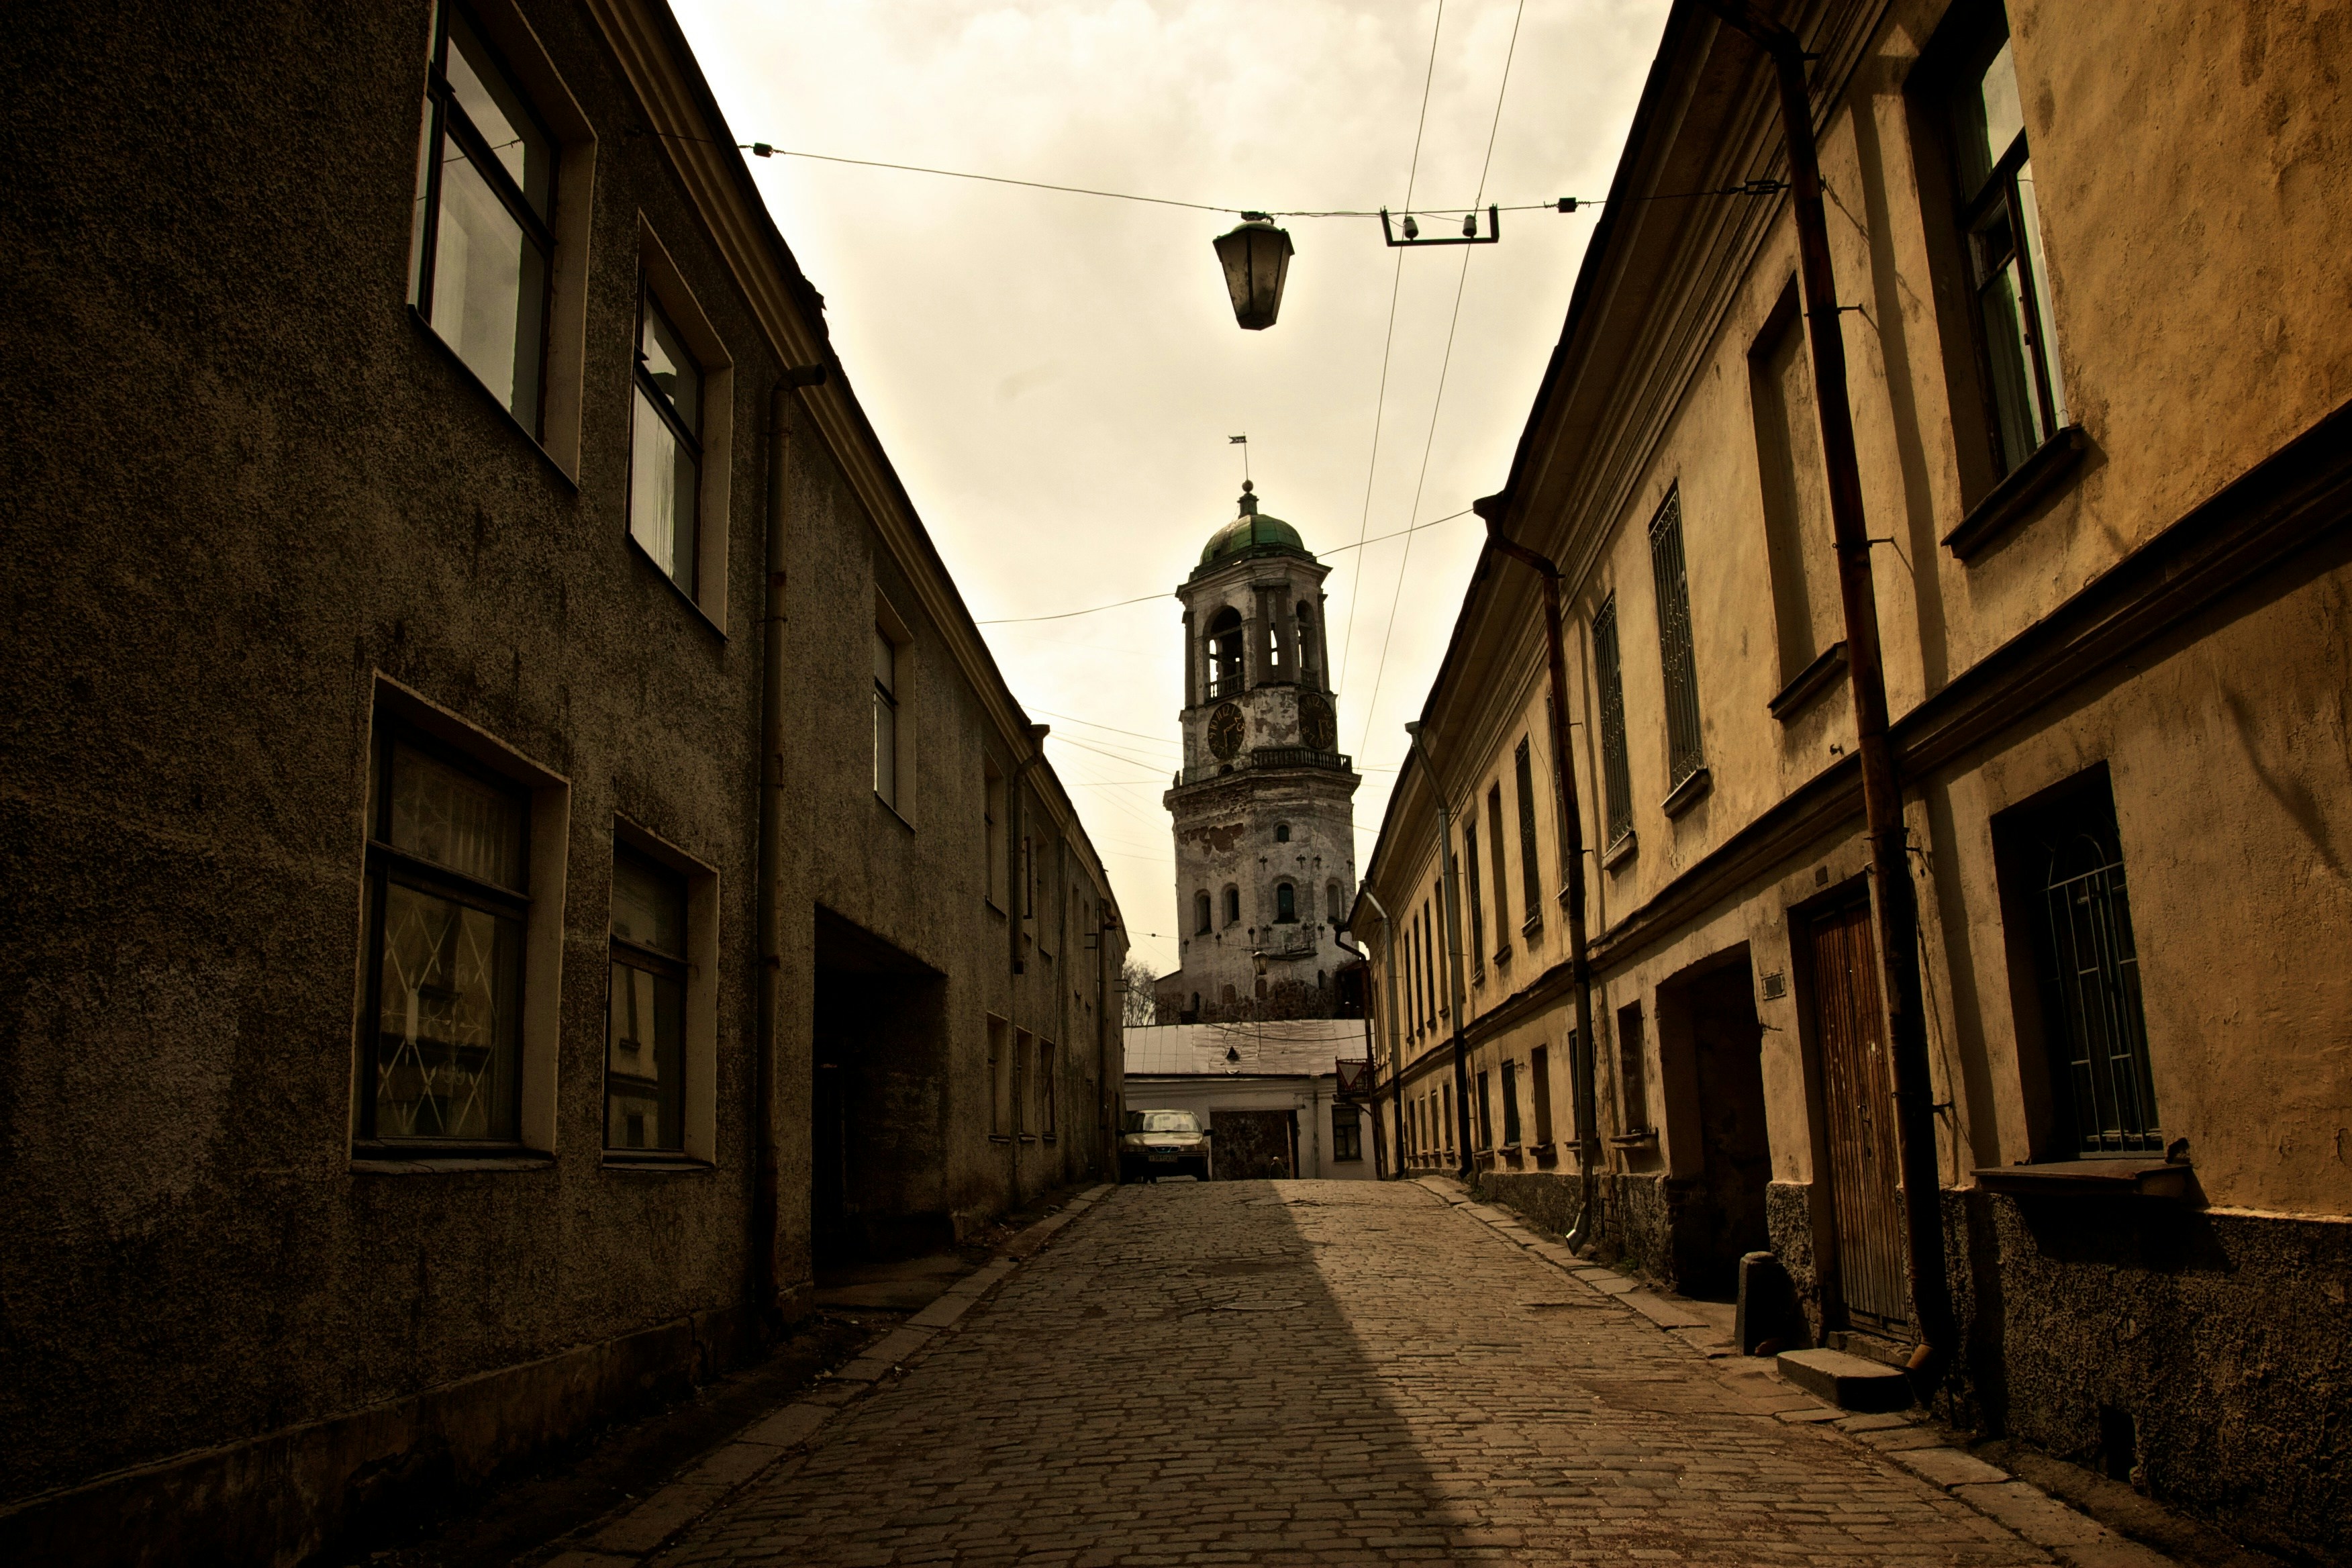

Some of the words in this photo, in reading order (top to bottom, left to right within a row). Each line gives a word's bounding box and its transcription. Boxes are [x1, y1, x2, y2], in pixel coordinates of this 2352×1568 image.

[1312, 695, 1320, 707] 12
[1222, 705, 1230, 717] 12
[1231, 705, 1236, 716] 1
[1234, 712, 1242, 723] 2
[1209, 720, 1219, 730] 10
[1236, 723, 1245, 732] 3
[1211, 741, 1219, 750] 8
[1219, 746, 1225, 758] 7
